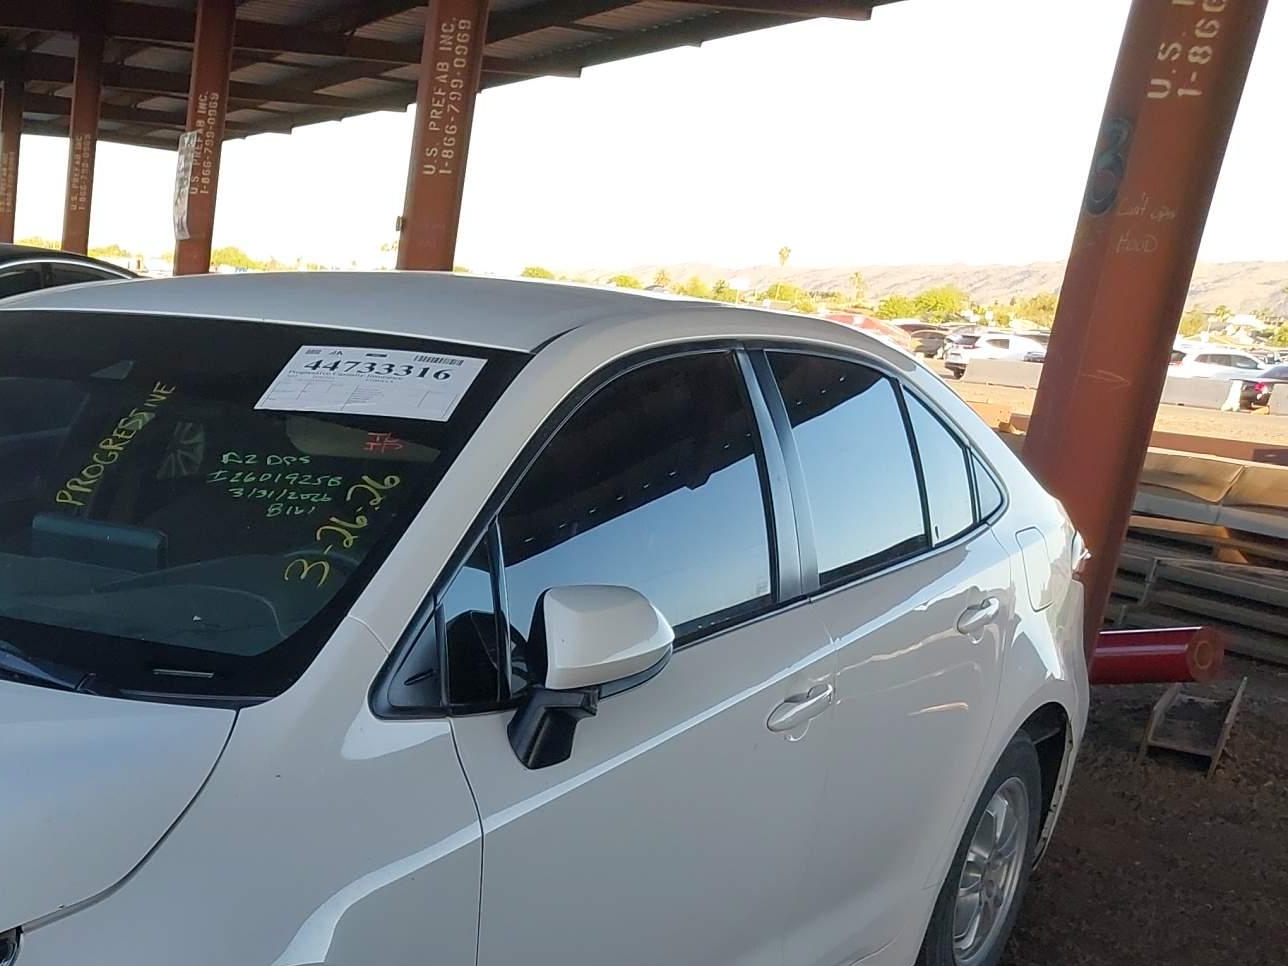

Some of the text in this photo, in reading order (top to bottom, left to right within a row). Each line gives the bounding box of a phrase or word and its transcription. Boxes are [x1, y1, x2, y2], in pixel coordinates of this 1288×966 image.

[192, 119, 206, 166] PREFAB
[422, 17, 457, 176] U.S. PREFAB INC.
[439, 19, 472, 175] 1-866-799-0969
[304, 358, 454, 381] 44733316
